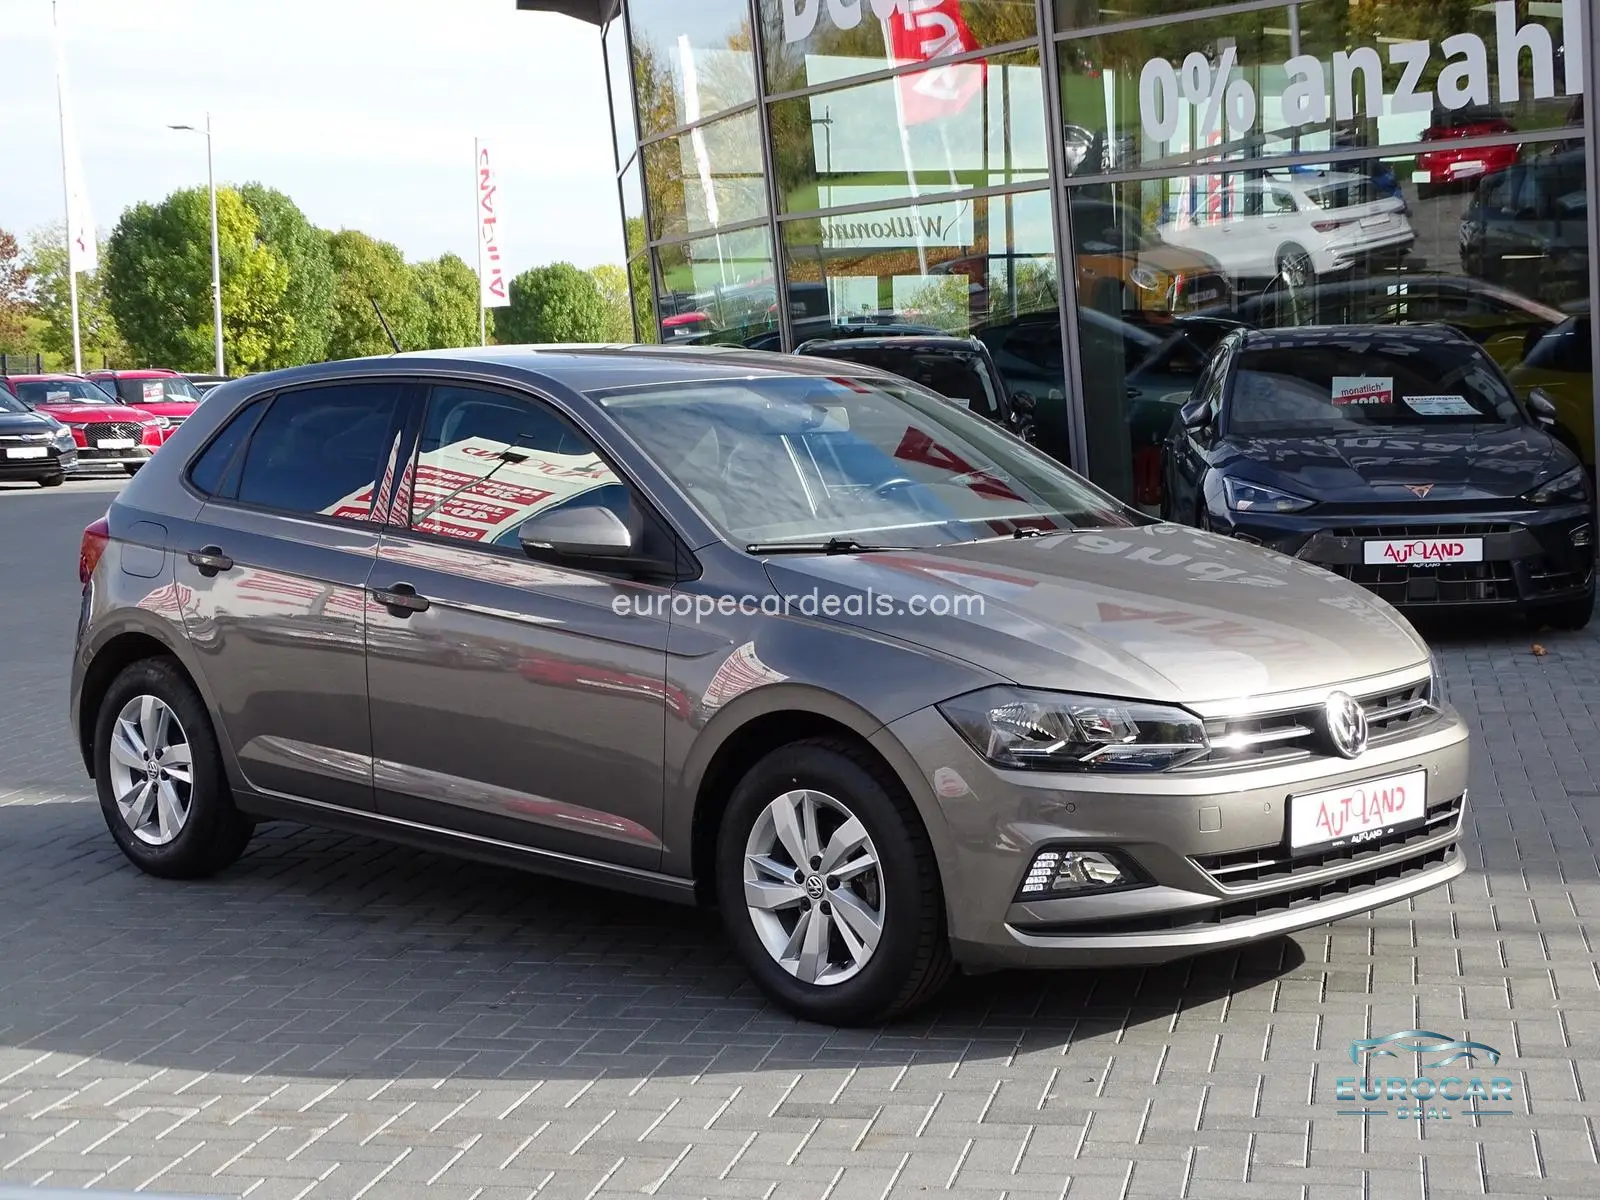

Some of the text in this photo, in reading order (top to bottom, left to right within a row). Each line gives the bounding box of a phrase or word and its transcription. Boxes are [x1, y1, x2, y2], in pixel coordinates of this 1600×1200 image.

[1139, 46, 1256, 143] 0%
[1384, 541, 1464, 562] AUTOLAND
[1316, 786, 1406, 836] AUTOLAND
